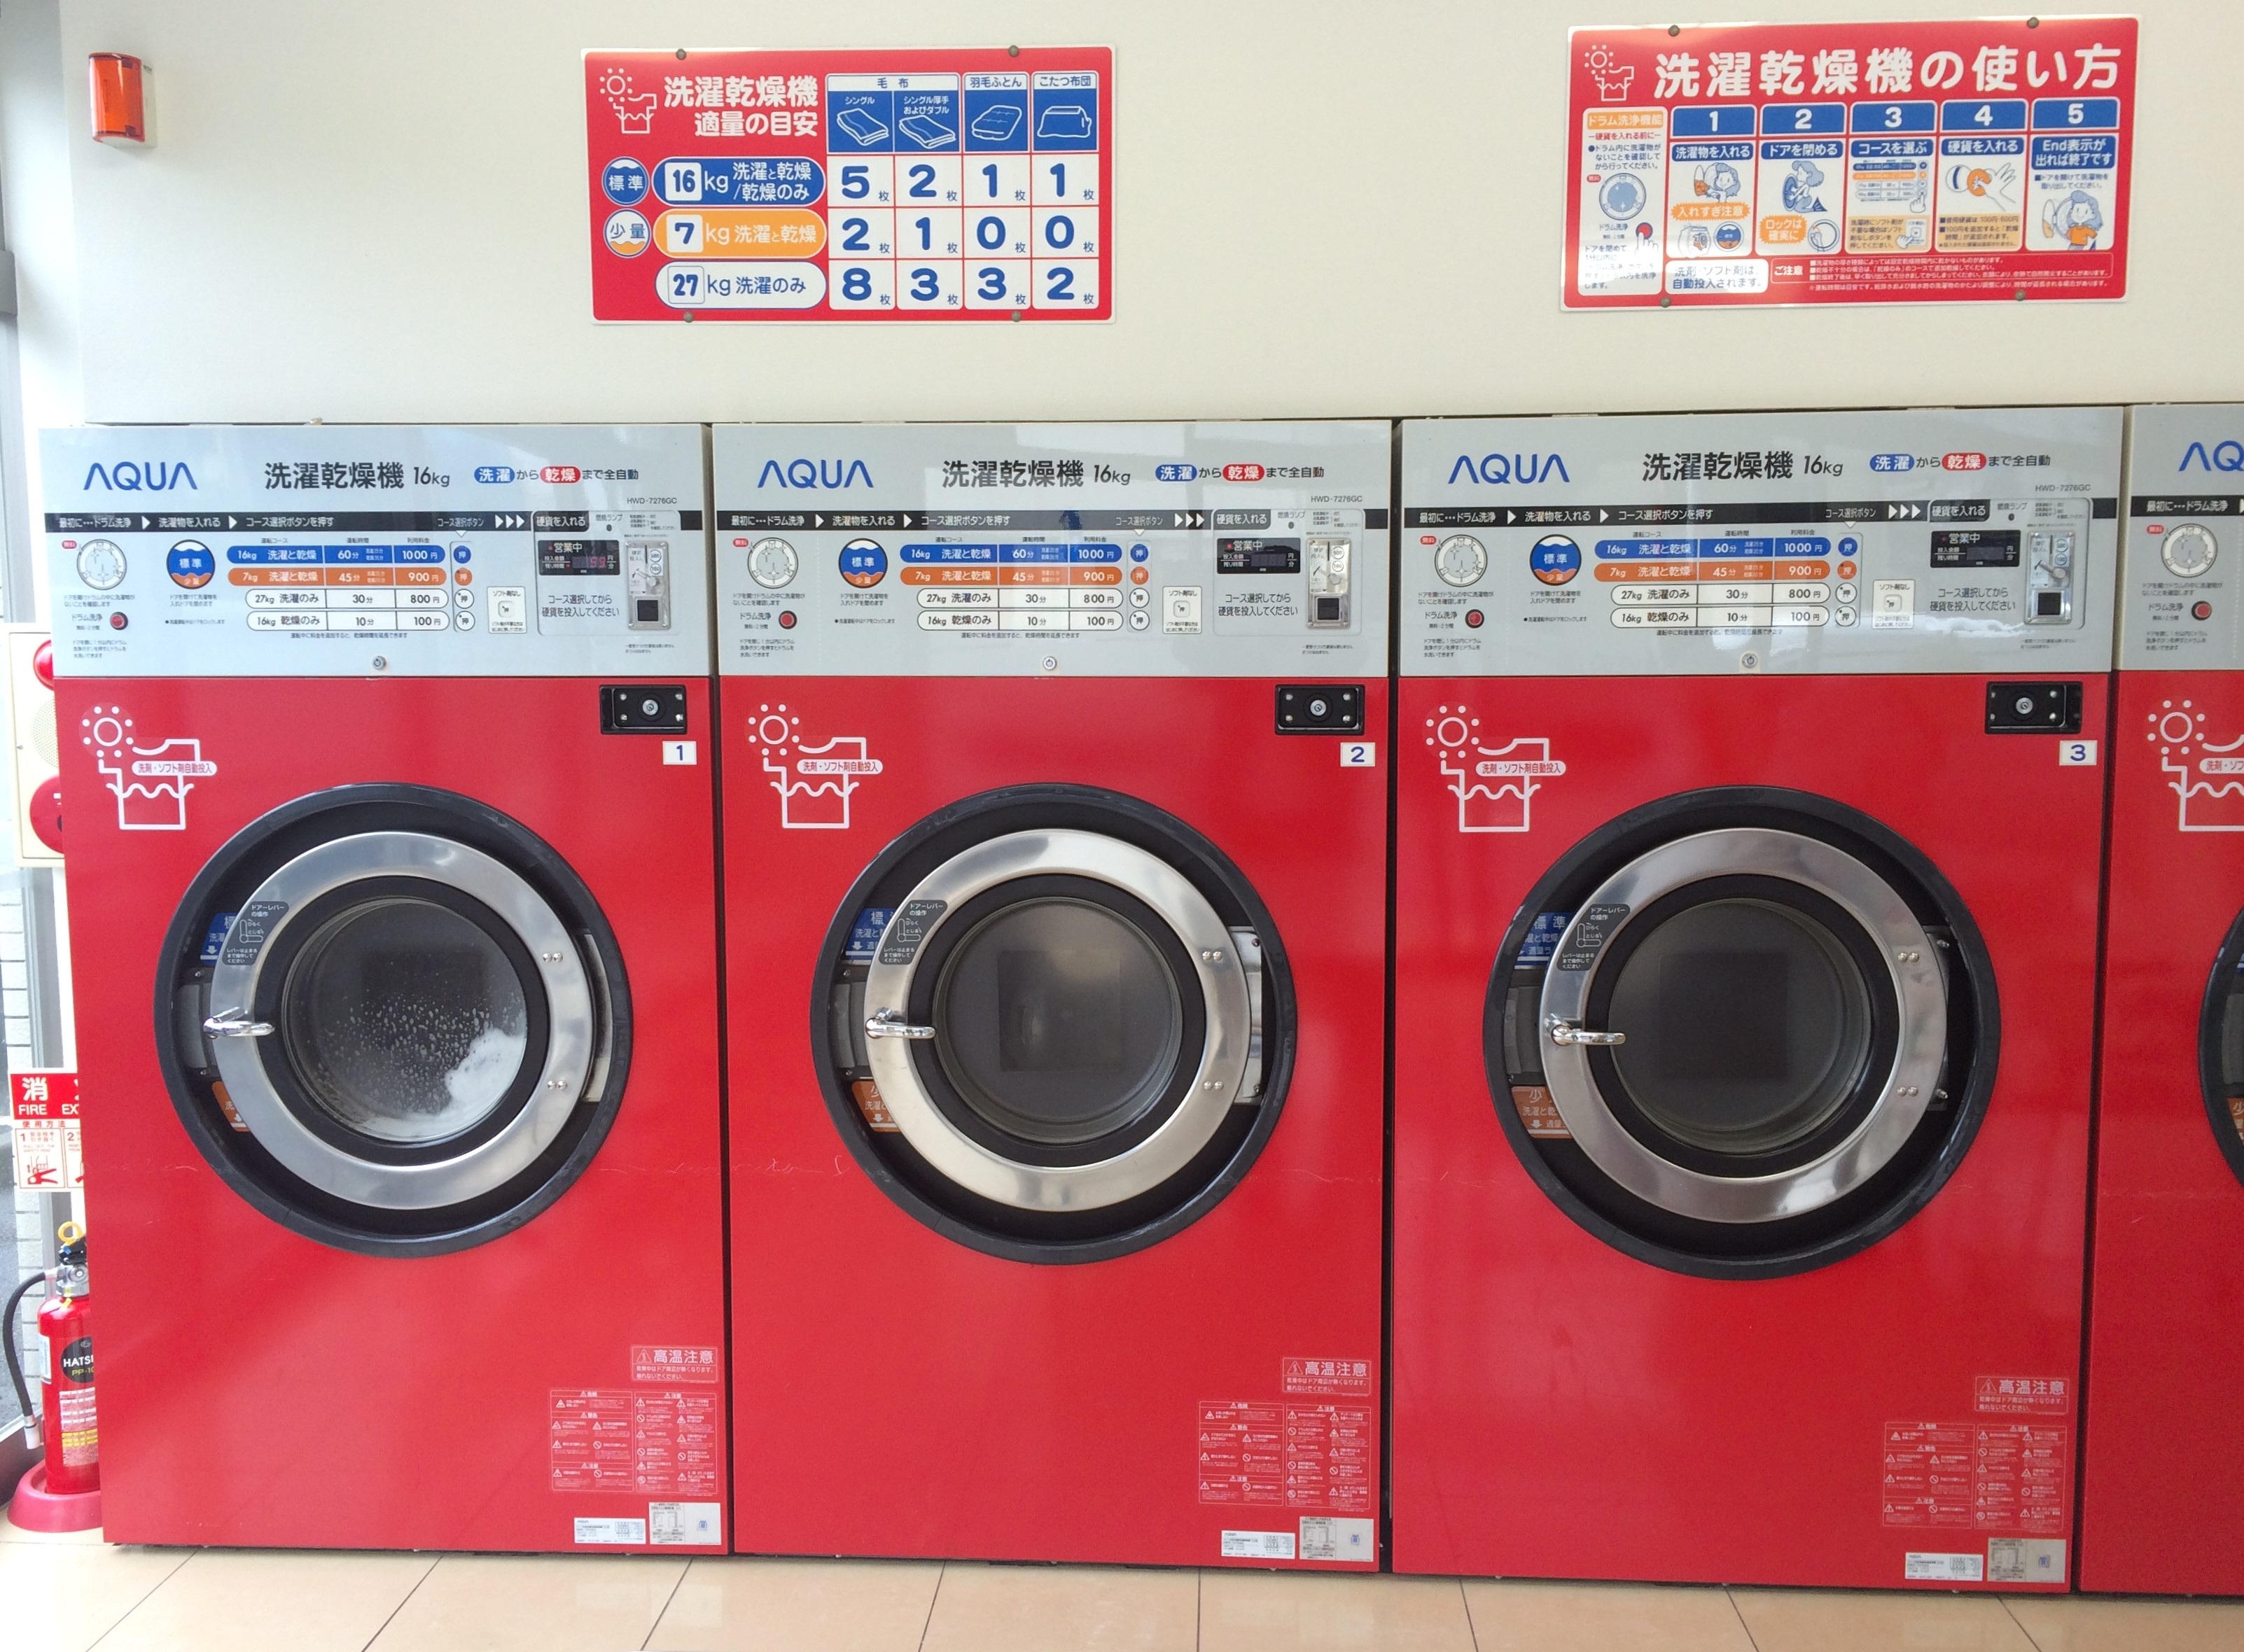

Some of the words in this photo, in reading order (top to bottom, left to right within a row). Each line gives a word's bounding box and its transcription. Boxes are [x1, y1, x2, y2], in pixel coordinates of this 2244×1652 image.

[1654, 43, 2122, 99] 洗濯乾燥機の使い方
[970, 76, 1022, 88] 羽毛ふとん
[1039, 76, 1092, 88] こたつ布団
[663, 76, 819, 108] 洗濯乾燥機
[844, 96, 874, 106] シングル
[903, 95, 949, 105] シングル厚手
[903, 106, 949, 115] およびダブル
[1974, 105, 1993, 126] 4
[2068, 104, 2084, 124] 5
[1589, 114, 1662, 126] ドラム洗浄機能
[1709, 111, 1717, 131] 1
[1795, 109, 1811, 129] 2
[1885, 107, 1902, 127] 3
[694, 111, 818, 136] 適量の目安
[1769, 144, 1837, 155] ドアを閉める
[1859, 141, 1928, 155] コースを選ぶ
[1948, 139, 2019, 153] 硬貨を入れる
[2042, 138, 2106, 151] End表示が
[1596, 153, 1660, 161] ないことを確認して
[1675, 146, 1750, 159] 洗濯物を入れる
[2035, 153, 2112, 166] 出れば終了です
[733, 162, 811, 181] 洗濯と乾燥
[608, 175, 643, 190] 標準
[1678, 206, 1743, 217] 入れすぎ注意
[610, 223, 645, 239] 少量
[1766, 220, 1802, 230] ロックは
[734, 225, 817, 244] 洗濯と乾燥
[1769, 230, 1799, 241] 確実に
[1774, 266, 1803, 276] ご注意
[735, 276, 807, 294] 洗濯のみ
[1448, 454, 1570, 484] AQUA
[1642, 451, 1793, 482] 洗濯乾燥機
[1804, 455, 1843, 476] 16kg
[84, 461, 197, 491] AQUA
[265, 462, 404, 489] 洗濯乾燥機
[413, 467, 450, 486] 16kg
[758, 460, 874, 489] AQUA
[942, 460, 1084, 488] 洗濯乾燥機
[1094, 465, 1131, 485] 16kg
[1525, 511, 1591, 522] 洗濯物を入れる
[1618, 510, 1713, 521] コース選択ボタンを押す
[1825, 507, 1876, 518] コース選択ボタン
[1932, 505, 1986, 516] 硬貨を入れる
[159, 517, 220, 528] 洗濯物を入れる
[246, 517, 333, 527] コース選択ボタンを押す
[438, 518, 484, 526] コース選択ボタン
[536, 516, 585, 526] 硬貨を入れる
[832, 516, 895, 526] 洗濯物を入れる
[921, 516, 1010, 526] コース選択ボタンを押す
[1115, 517, 1163, 526] コース選択ボタン
[1217, 514, 1267, 524] 硬貨を入れる
[1949, 533, 1980, 544] 営業中
[554, 543, 582, 552] 営業中
[1233, 541, 1262, 550] 営業中
[1606, 545, 1626, 555] 16kg
[1638, 543, 1691, 554] 洗濯と乾燥
[237, 551, 256, 561] 16kg
[267, 549, 316, 561] 洗濯と乾燥
[912, 550, 931, 559] 16kg
[942, 549, 991, 559] 洗濯と乾燥
[179, 559, 202, 568] 標準
[243, 573, 258, 583] 7kg
[269, 571, 318, 582] 洗濯と乾燥
[916, 572, 931, 582] 7kg
[942, 570, 991, 582] 洗濯と乾燥
[927, 594, 946, 604] 27kg
[951, 592, 991, 603] 洗濯のみ
[1225, 594, 1291, 603] コース選択してから
[1938, 587, 2008, 598] コース選択してから
[255, 595, 274, 605] 27kg
[279, 594, 319, 603] 洗濯のみ
[548, 594, 612, 604] コース選択してから
[542, 607, 619, 617] 硬貨を投入してください
[1218, 606, 1298, 617] 硬貨を投入してください
[1930, 600, 2015, 612] 硬貨を投入してください
[257, 617, 275, 626] 16kg
[281, 616, 320, 626] 乾燥のみ
[1622, 612, 1641, 623] 16kg
[1647, 612, 1689, 622] 乾燥のみ
[676, 745, 683, 760] 1
[1351, 747, 1365, 762] 2
[2070, 745, 2086, 761] 3
[18, 1105, 48, 1115] FIRE
[62, 1104, 79, 1114] EX
[654, 1350, 713, 1364] 高温注意
[1305, 1362, 1367, 1376] 高温注意
[2000, 1380, 2064, 1394] 高温注意
